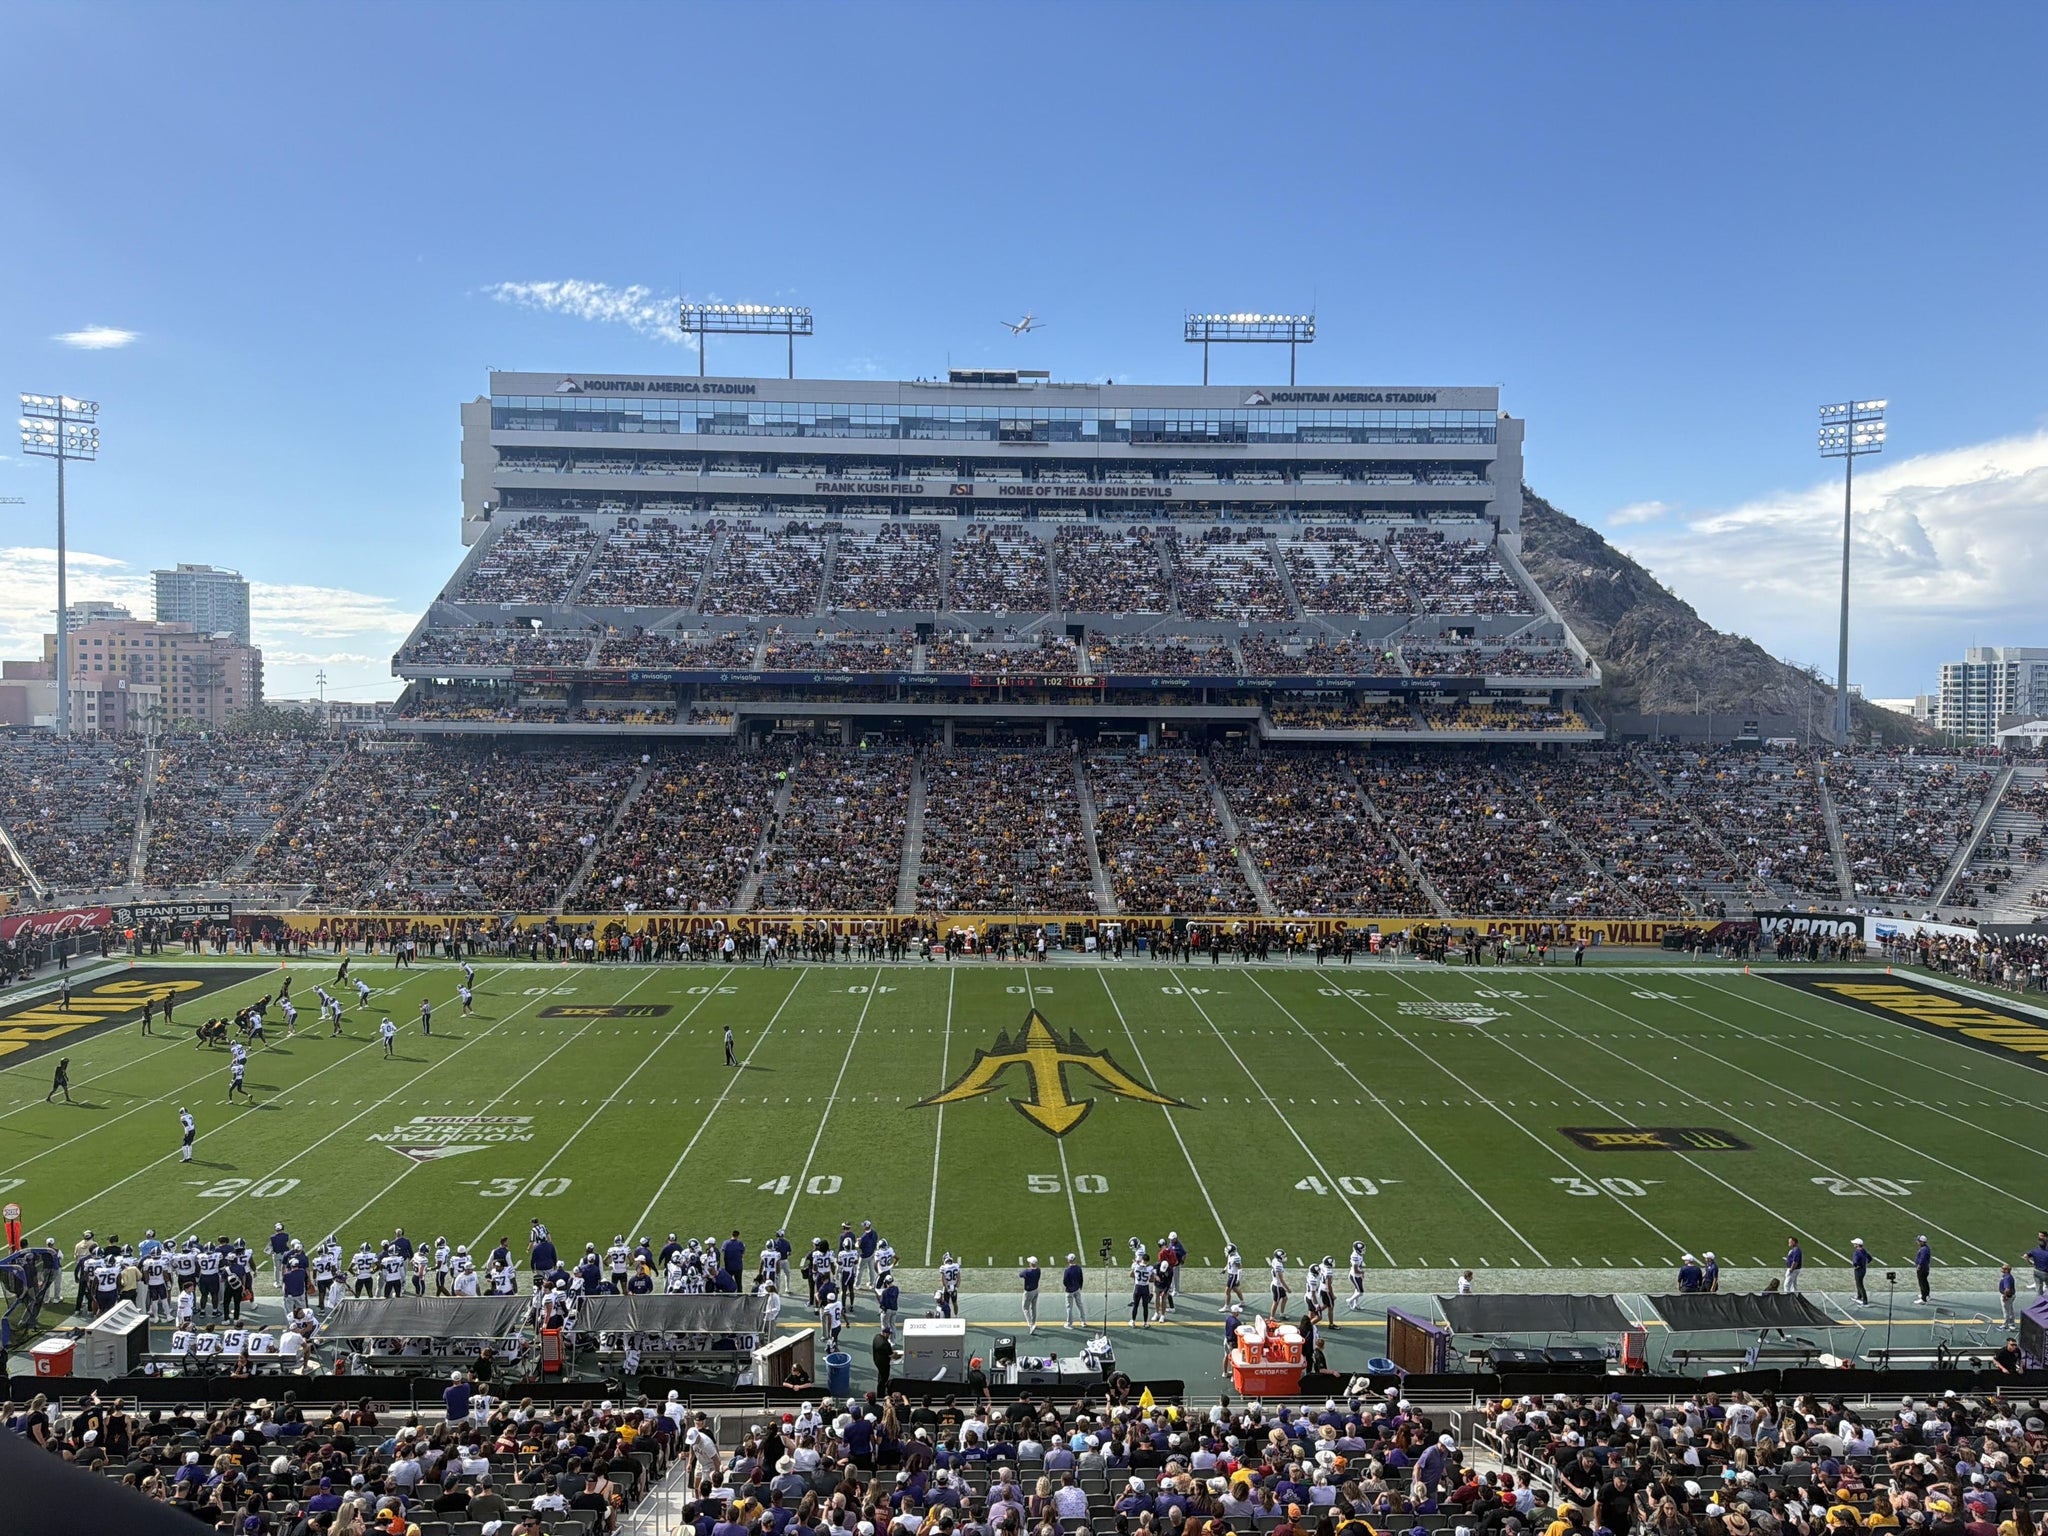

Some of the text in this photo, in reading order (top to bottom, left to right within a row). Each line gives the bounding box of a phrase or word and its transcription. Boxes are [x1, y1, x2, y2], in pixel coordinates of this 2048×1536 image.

[584, 380, 756, 394] MOUNTAIN AMERICA STADIUM
[1271, 392, 1437, 403] MOUNTAIN AMERICA STADIUM
[815, 482, 924, 495] FRANK KUSH FIELD
[950, 484, 974, 496] ASU
[1000, 486, 1173, 497] HOME OF THE ASU SUN DEVILS
[705, 519, 727, 532] 42
[881, 523, 901, 535] 33
[901, 522, 941, 530] WILFORD
[966, 524, 987, 537] 27
[1056, 525, 1071, 537] 11
[1127, 525, 1149, 538] 40
[1303, 526, 1326, 540] 62
[642, 673, 672, 681] invisalign
[731, 674, 760, 682] invisalign
[824, 675, 853, 683] invisalign
[909, 676, 938, 684] invisalign
[1043, 677, 1062, 686] 1:02
[1071, 677, 1082, 686] 10
[1161, 678, 1190, 686] invisalign
[1247, 679, 1276, 687] invisalign
[1326, 679, 1356, 687] invisalign
[1411, 680, 1441, 688] invisalign
[135, 904, 230, 917] BRANDED BILLS
[1760, 916, 1857, 937] venmo
[1875, 921, 1898, 930] Chevron
[522, 987, 578, 996] 20
[687, 986, 739, 995] 30
[847, 986, 898, 994] 40
[1006, 986, 1055, 994] 50
[1161, 986, 1211, 995] 40
[393, 1125, 535, 1133] AMERICA
[365, 1133, 535, 1142] MOUNTAIN
[196, 1178, 301, 1198] 20
[479, 1178, 573, 1197] 30
[757, 1175, 844, 1195] 40
[1028, 1174, 1109, 1194] 50
[1295, 1175, 1380, 1196] 40
[1551, 1177, 1648, 1197] 30
[1810, 1177, 1913, 1196] 20
[611, 1252, 626, 1264] 23
[763, 1257, 776, 1269] 14
[816, 1257, 832, 1268] 20
[178, 1259, 192, 1270] 19
[200, 1259, 216, 1271] 97
[317, 1263, 331, 1274] 34
[357, 1259, 374, 1271] 25
[386, 1262, 400, 1273] 47
[148, 1265, 163, 1277] 40
[1134, 1269, 1150, 1282] 35
[99, 1273, 116, 1286] 76
[225, 1334, 241, 1347] 45
[251, 1337, 260, 1351] 0
[740, 1335, 753, 1350] 10
[1250, 1345, 1259, 1355] G
[1289, 1345, 1299, 1355] G
[37, 1358, 51, 1374] G
[374, 1404, 386, 1413] 30
[88, 1416, 99, 1430] 0
